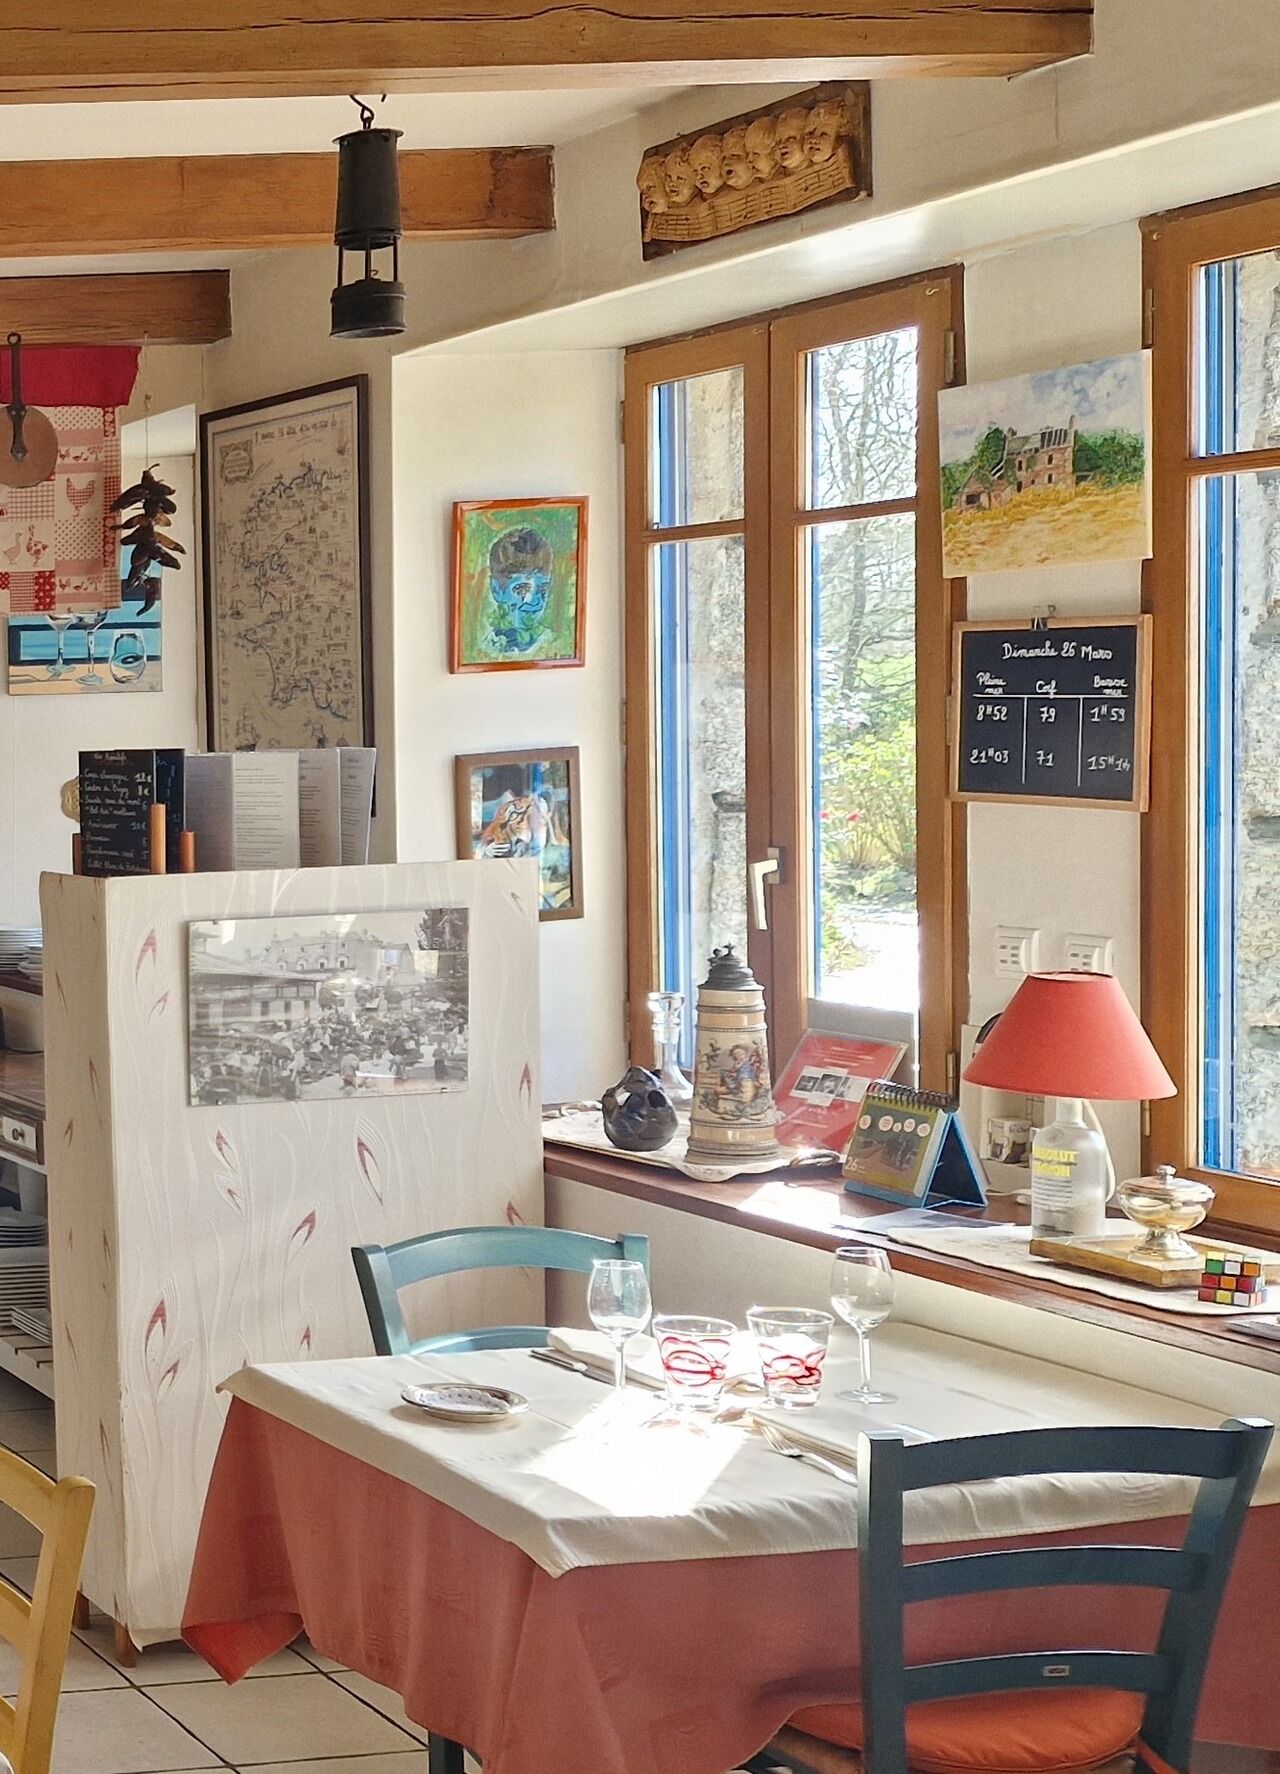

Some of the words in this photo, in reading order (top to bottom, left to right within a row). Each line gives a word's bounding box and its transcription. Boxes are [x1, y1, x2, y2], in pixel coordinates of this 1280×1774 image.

[1002, 641, 1059, 660] Dimanche
[1061, 641, 1077, 657] 26
[1081, 645, 1113, 661] Mars
[976, 672, 1007, 686] Pleine
[1039, 707, 1056, 722] 79
[1036, 750, 1055, 766] 71
[845, 1156, 858, 1172] 26
